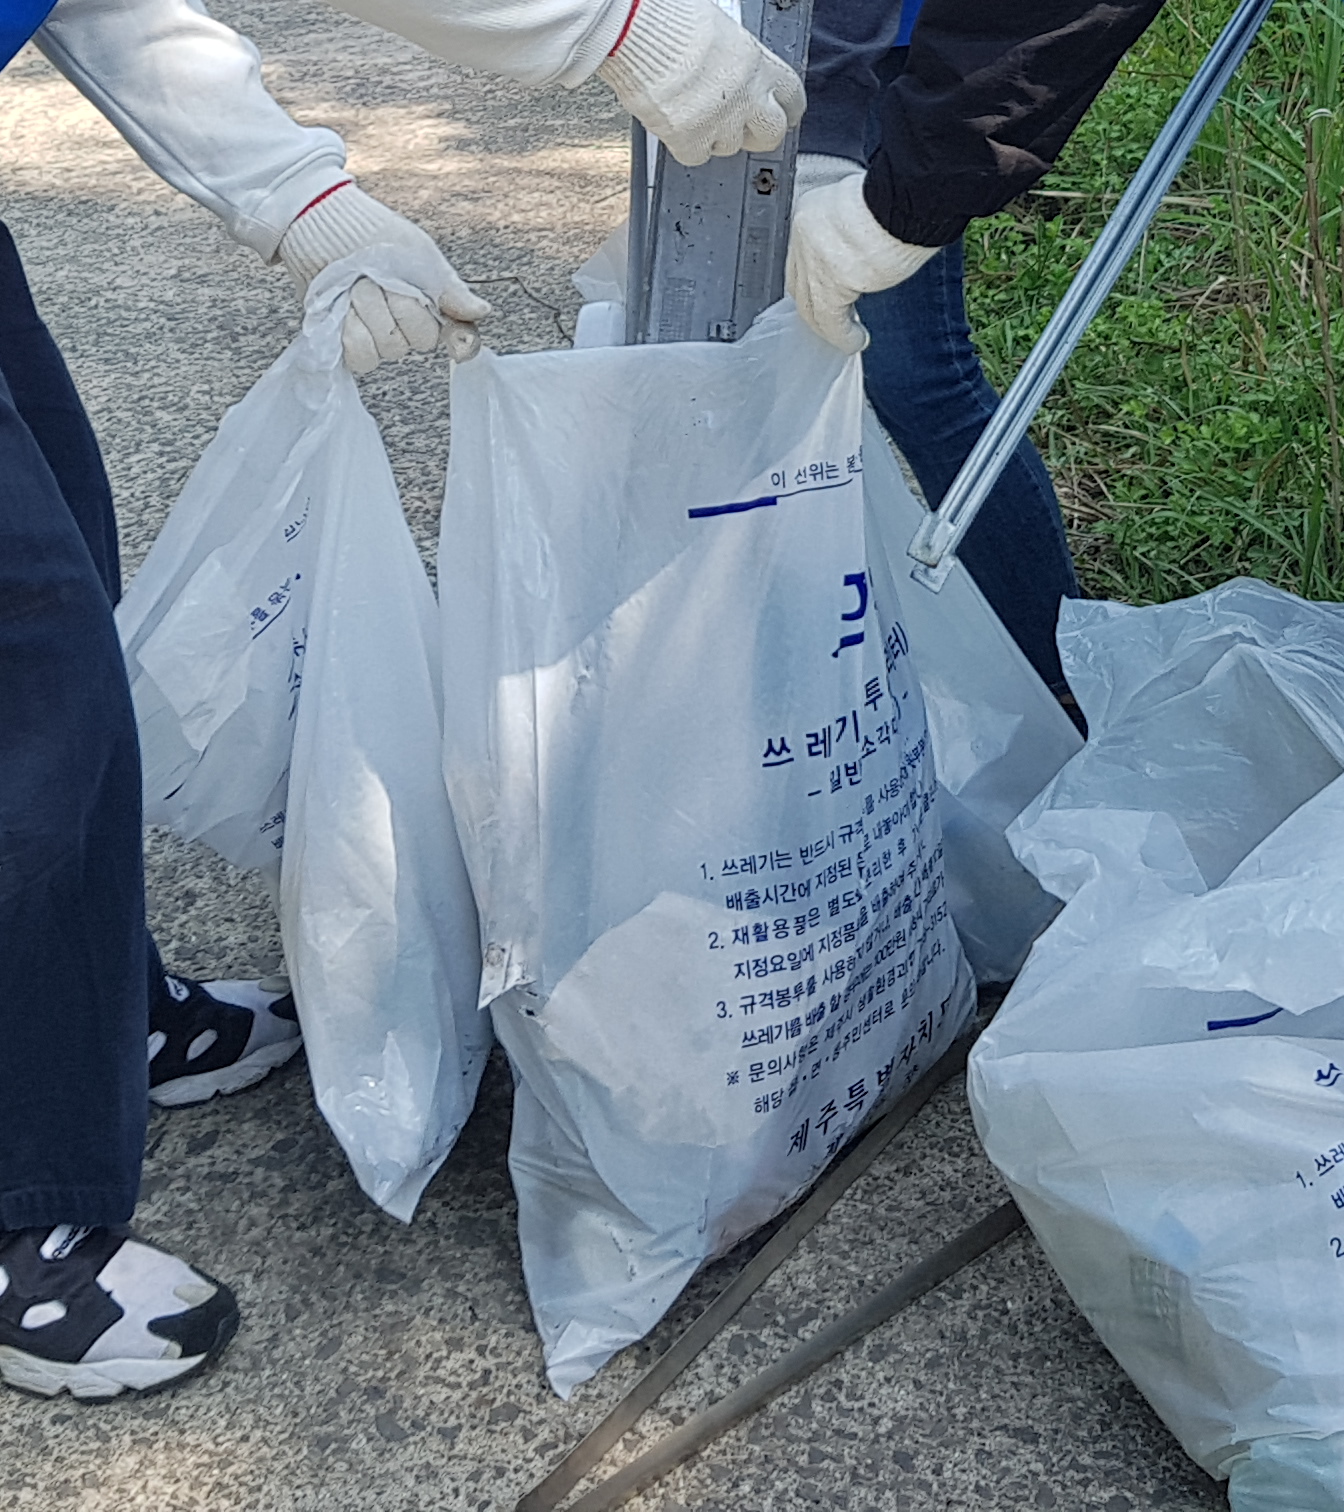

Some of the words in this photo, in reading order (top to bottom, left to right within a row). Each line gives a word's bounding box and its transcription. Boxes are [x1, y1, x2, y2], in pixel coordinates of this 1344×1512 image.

[770, 470, 786, 489] 이
[700, 862, 715, 881] 1.
[721, 849, 793, 877] 쓰레기는
[725, 878, 812, 912] 배출시간에
[815, 856, 853, 890] 지정된
[708, 931, 726, 950] 2.
[731, 906, 822, 946] 재활용품은
[733, 942, 815, 980] 지정요일에
[716, 1000, 733, 1020] 3.
[739, 973, 818, 1016] 규격봉투를
[741, 1015, 803, 1050] 쓰레기를
[753, 1087, 785, 1114] 해당
[1295, 1170, 1314, 1189] 1.
